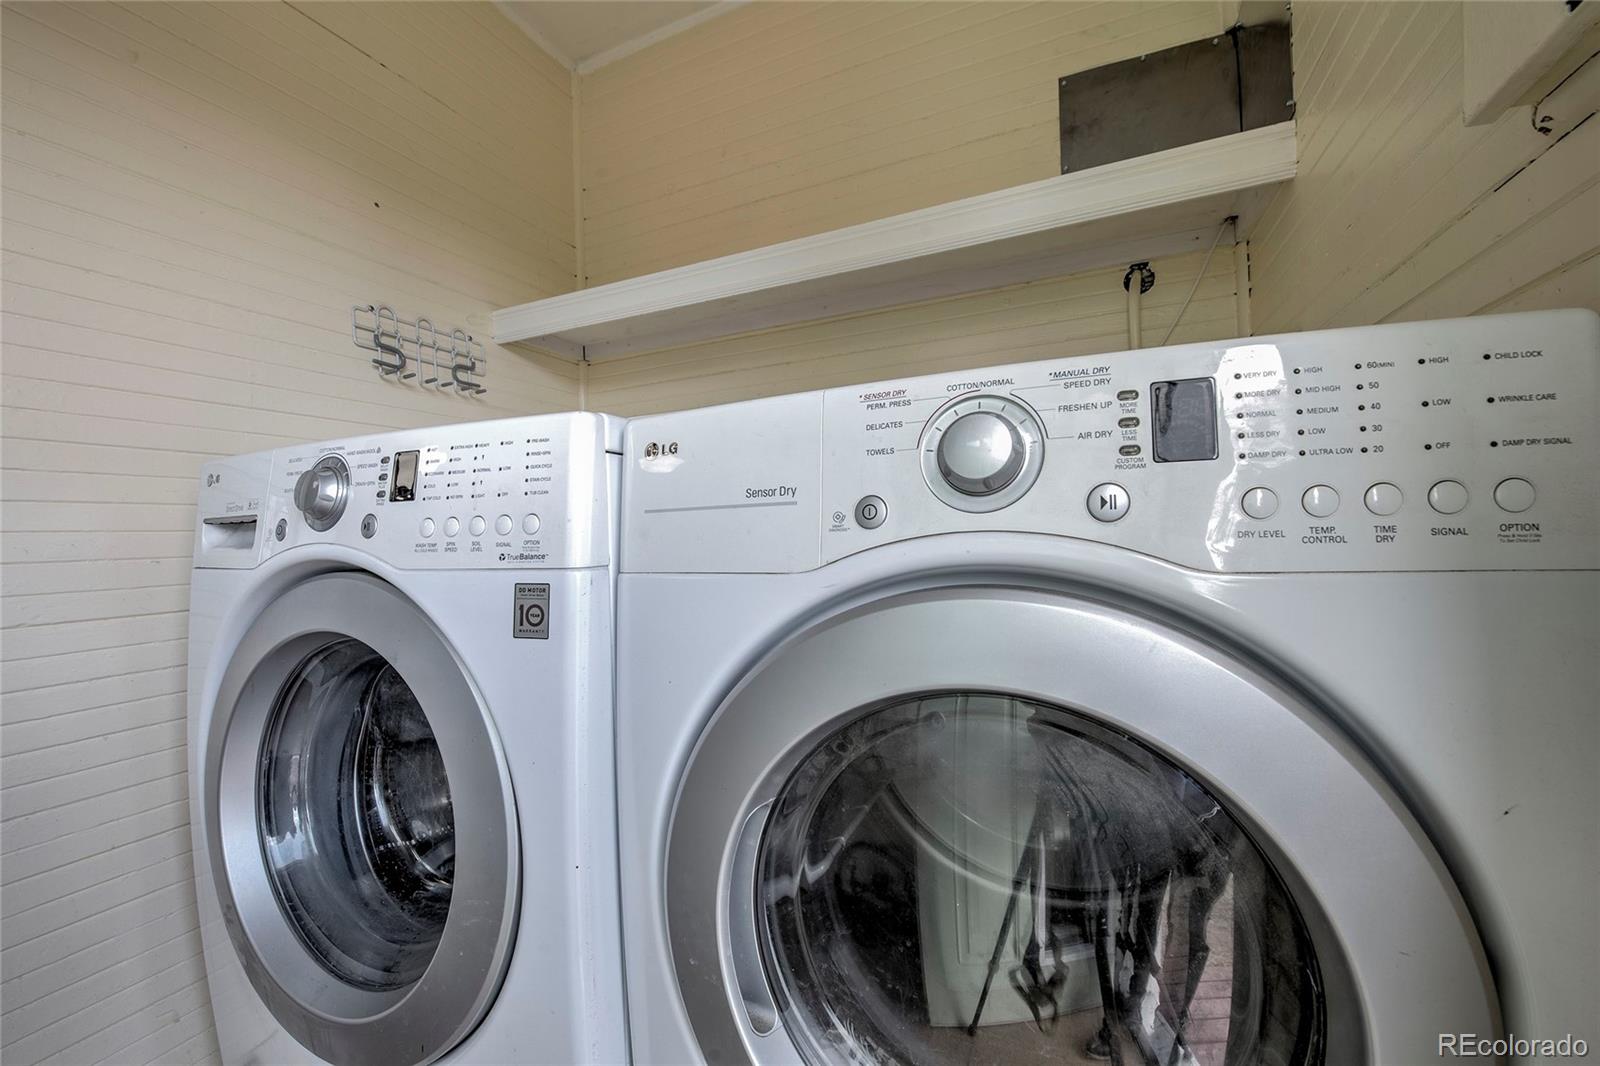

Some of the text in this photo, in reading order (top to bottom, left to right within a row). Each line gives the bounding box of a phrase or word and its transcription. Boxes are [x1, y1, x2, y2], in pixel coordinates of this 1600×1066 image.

[1494, 350, 1544, 360] CHILD LOCK
[1428, 356, 1449, 364] HIGH
[1052, 366, 1111, 378] MANUAL DRY
[1262, 370, 1277, 378] DRY
[1304, 366, 1323, 374] HIGH
[946, 378, 1015, 392] COTTON/NORMAL
[1063, 378, 1112, 390] SPEED DRY
[1368, 382, 1380, 390] 50
[863, 389, 907, 400] SENSOR DRY
[1266, 389, 1281, 397] DRY
[1432, 398, 1451, 406] LOW
[1498, 393, 1557, 403] WRINKLE CARE
[866, 400, 912, 410] PERM. PRESS
[1058, 401, 1113, 412] FRESHEN UP
[1370, 402, 1381, 410] 40
[1246, 410, 1277, 418] NORMAL
[1306, 406, 1340, 414] MEDIUM
[866, 421, 904, 431] DELICATES
[1372, 424, 1383, 432] 30
[1077, 430, 1113, 440] AIR DRY
[1266, 430, 1281, 438] DRY
[1435, 442, 1451, 450] OFF
[1502, 437, 1573, 447] DAMP DRY SIGNAL
[866, 447, 895, 456] TOWELS
[1309, 447, 1354, 456] ULTRA LOW
[1372, 445, 1384, 453] 20
[1271, 450, 1287, 458] DRY
[745, 485, 797, 499] Sensor Dry
[1309, 526, 1336, 535] TEMP.
[1374, 525, 1398, 534] TIME
[1430, 527, 1469, 536] SIGNAL
[1500, 522, 1540, 532] OPTION
[1236, 530, 1286, 539] DRY LEVEL
[1375, 534, 1396, 543] DRY
[1301, 535, 1348, 544] CONTROL
[518, 604, 545, 627] 10
